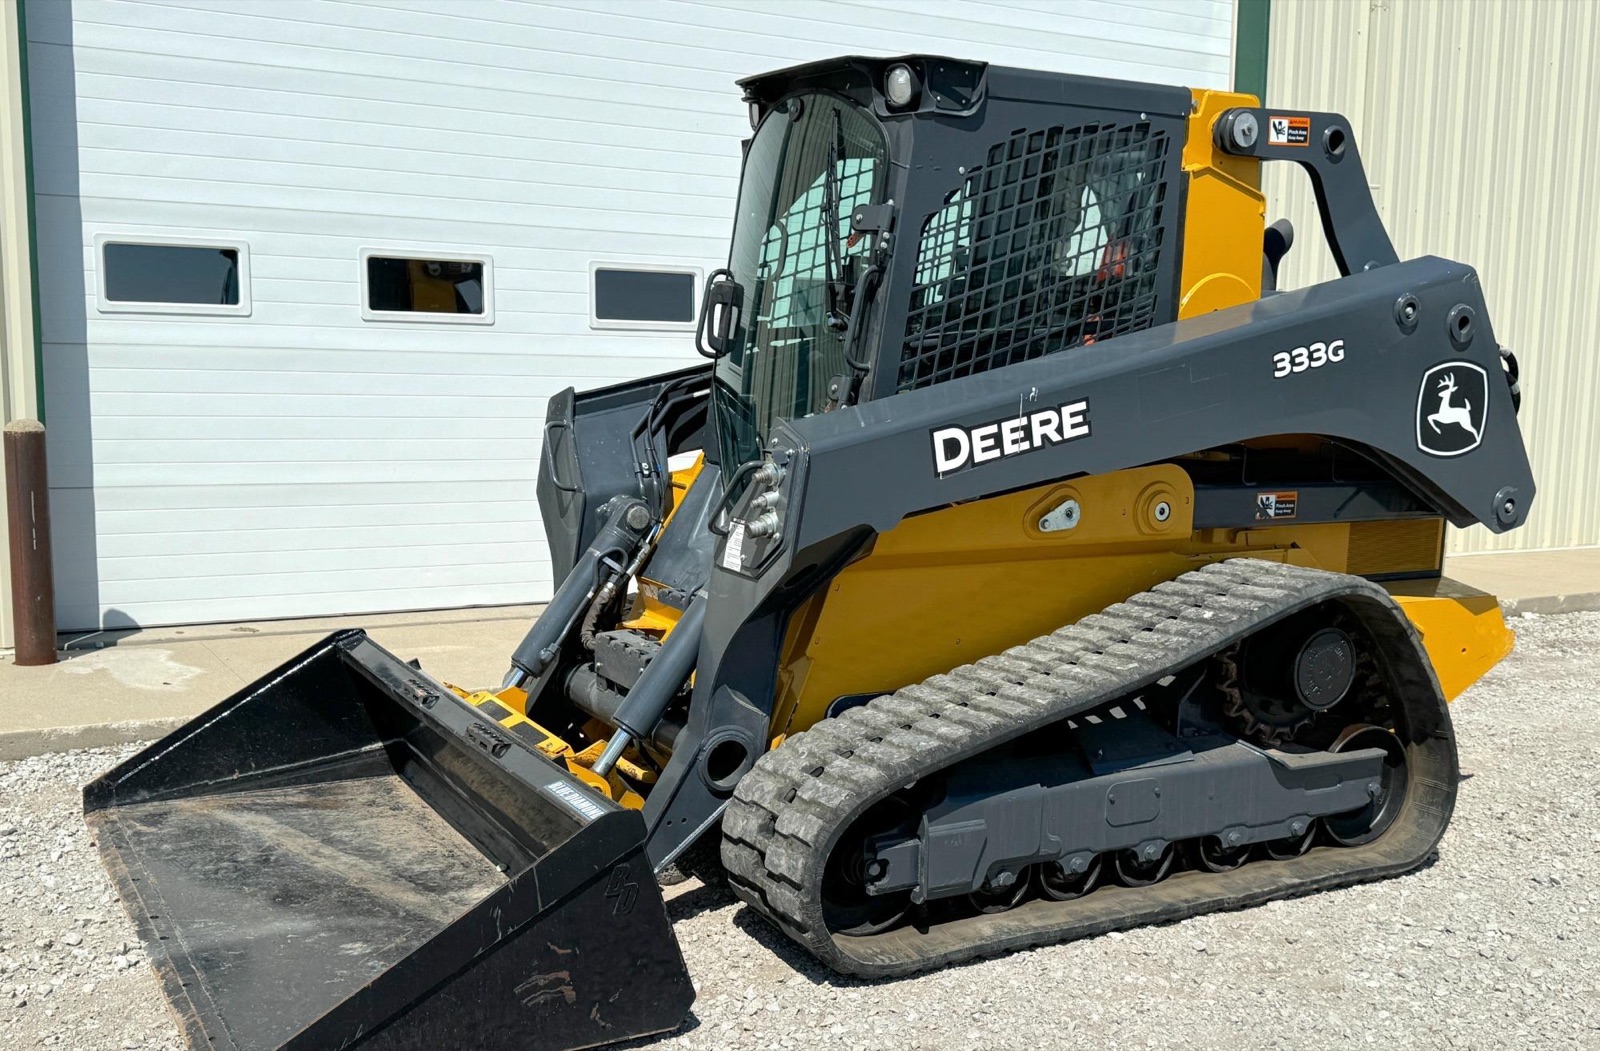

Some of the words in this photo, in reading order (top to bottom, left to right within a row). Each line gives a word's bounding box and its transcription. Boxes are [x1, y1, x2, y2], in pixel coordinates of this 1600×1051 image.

[1273, 339, 1345, 378] 333G
[933, 401, 1089, 473] DEERE
[547, 781, 574, 797] BLUE
